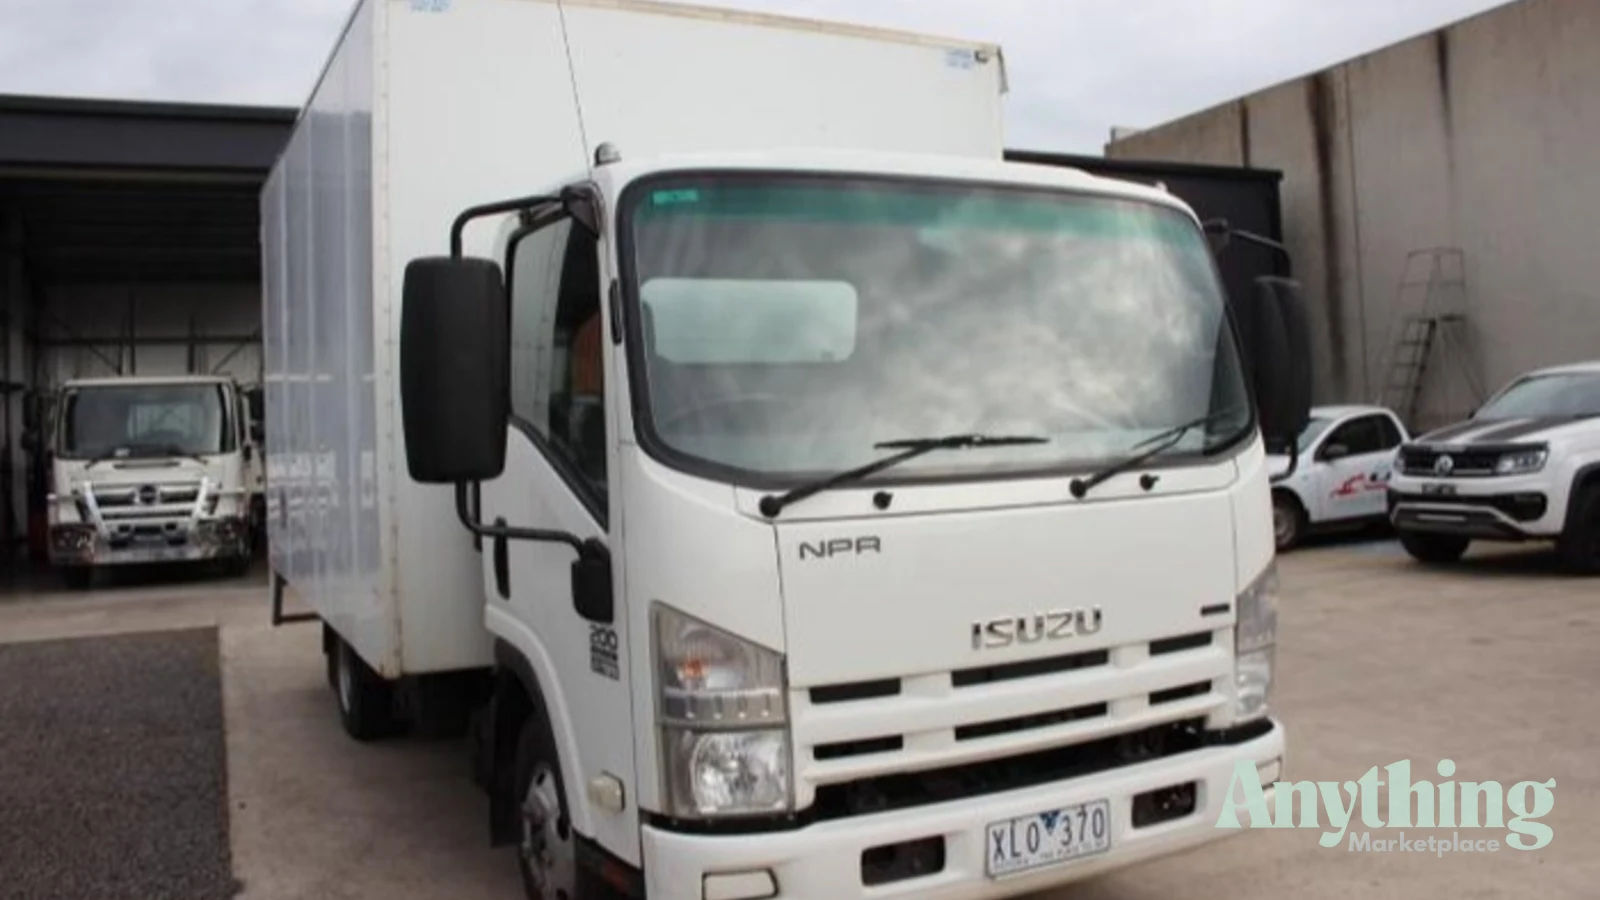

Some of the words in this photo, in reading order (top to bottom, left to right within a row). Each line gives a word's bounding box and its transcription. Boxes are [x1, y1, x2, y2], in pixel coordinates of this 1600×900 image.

[799, 536, 881, 560] NPR
[971, 607, 1103, 650] ISUZU
[1061, 807, 1105, 846] 370
